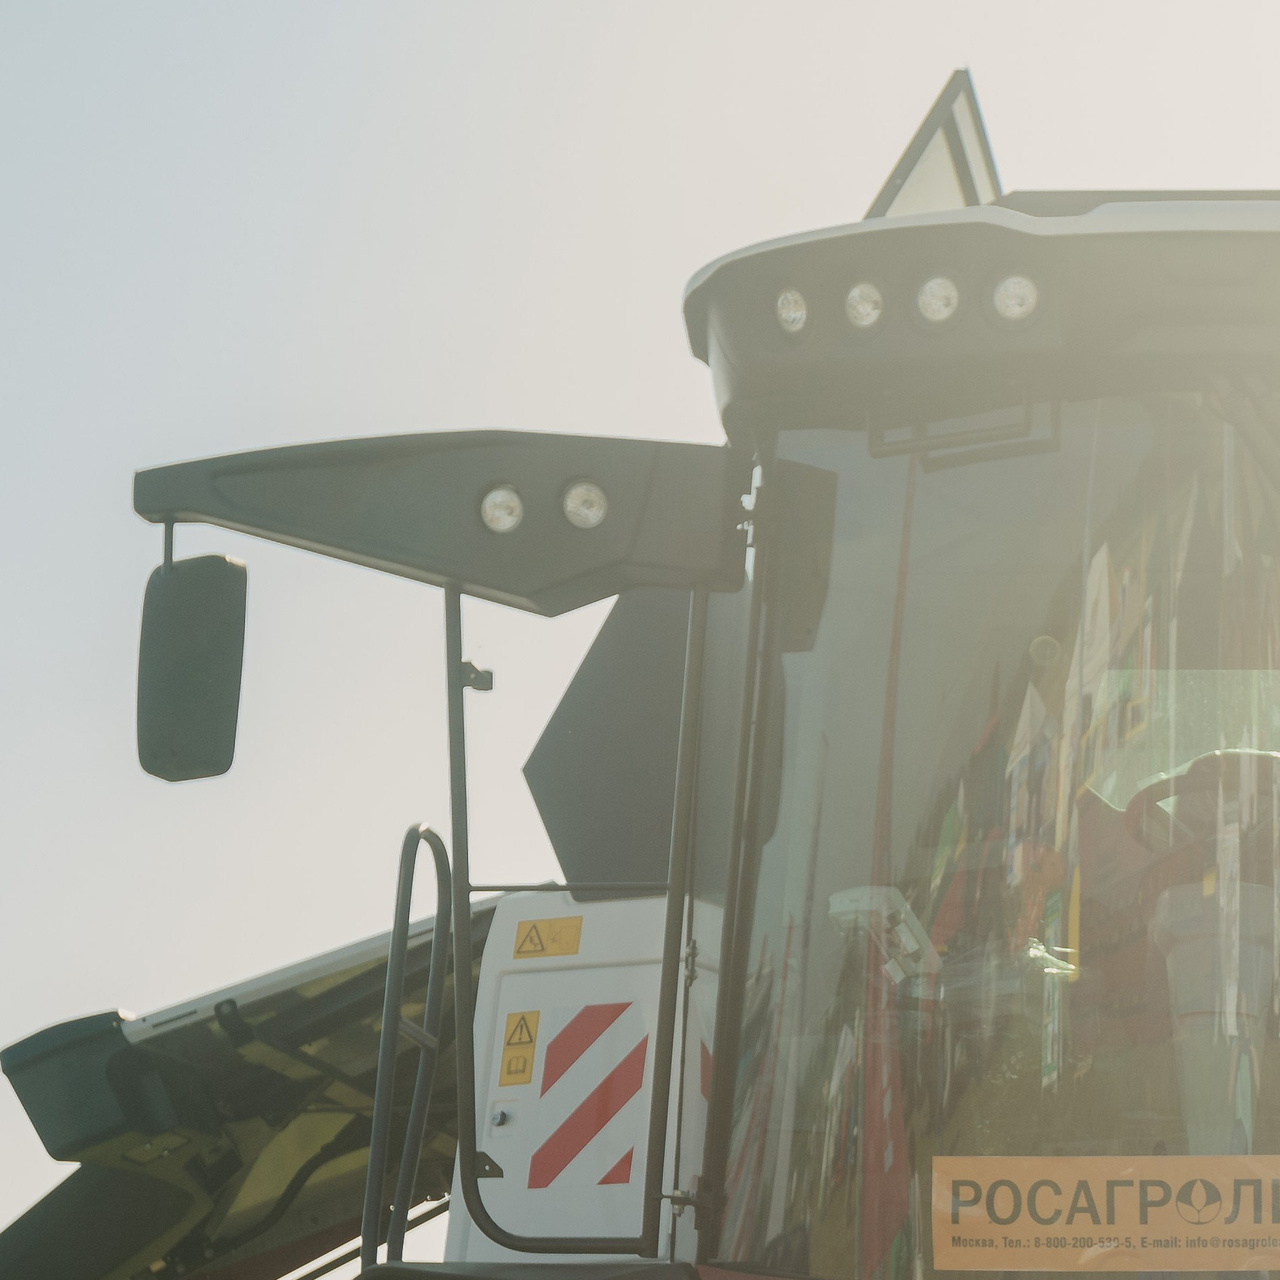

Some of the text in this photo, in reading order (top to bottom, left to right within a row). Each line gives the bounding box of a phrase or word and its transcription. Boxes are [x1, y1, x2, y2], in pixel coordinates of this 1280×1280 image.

[951, 1236, 998, 1250] Москва,
[1002, 1236, 1030, 1249] Тел.:
[1140, 1236, 1182, 1249] E-mail:
